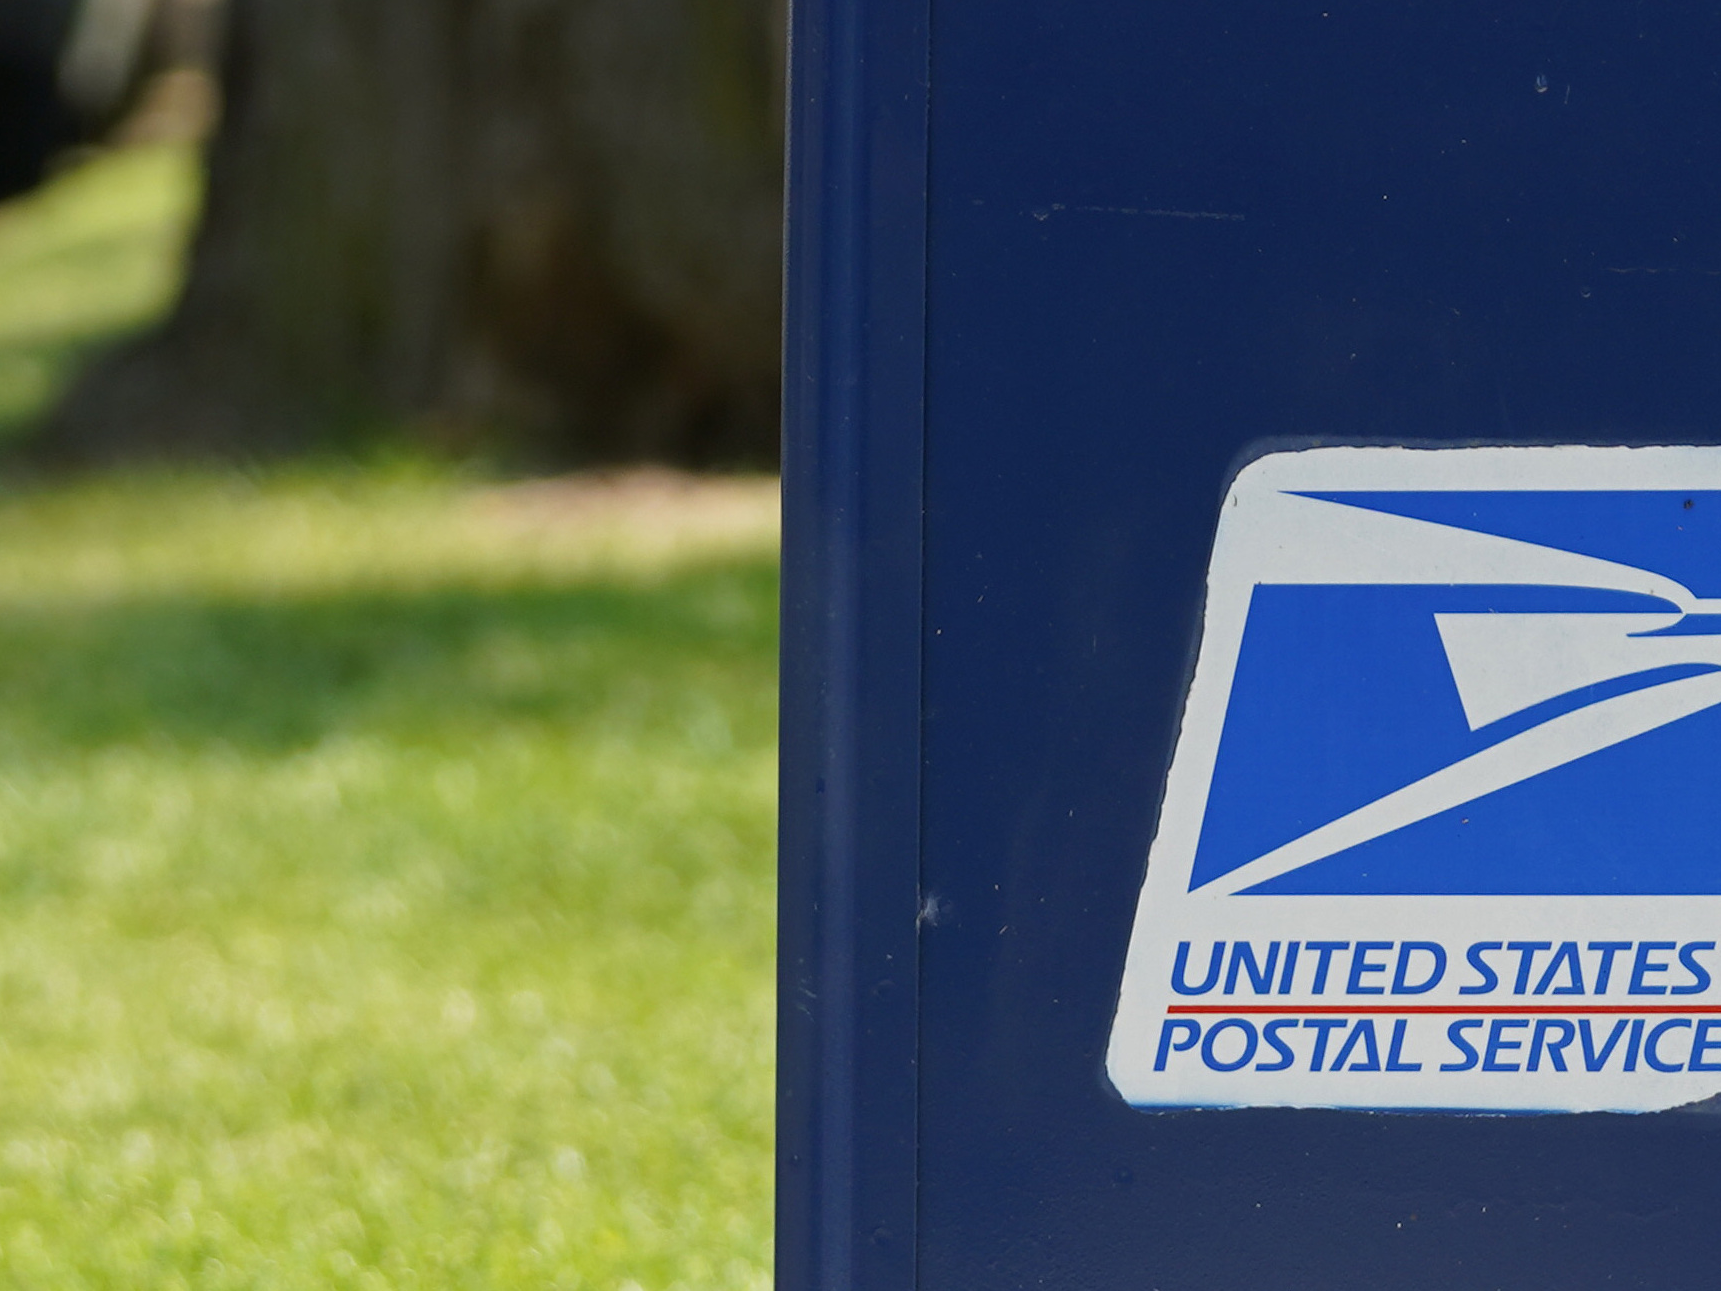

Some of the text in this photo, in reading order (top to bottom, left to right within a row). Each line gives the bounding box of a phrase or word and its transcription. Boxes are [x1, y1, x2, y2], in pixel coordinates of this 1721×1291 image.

[1170, 940, 1717, 996] UNITED STATES
[1152, 1018, 1423, 1073] POSTAL
